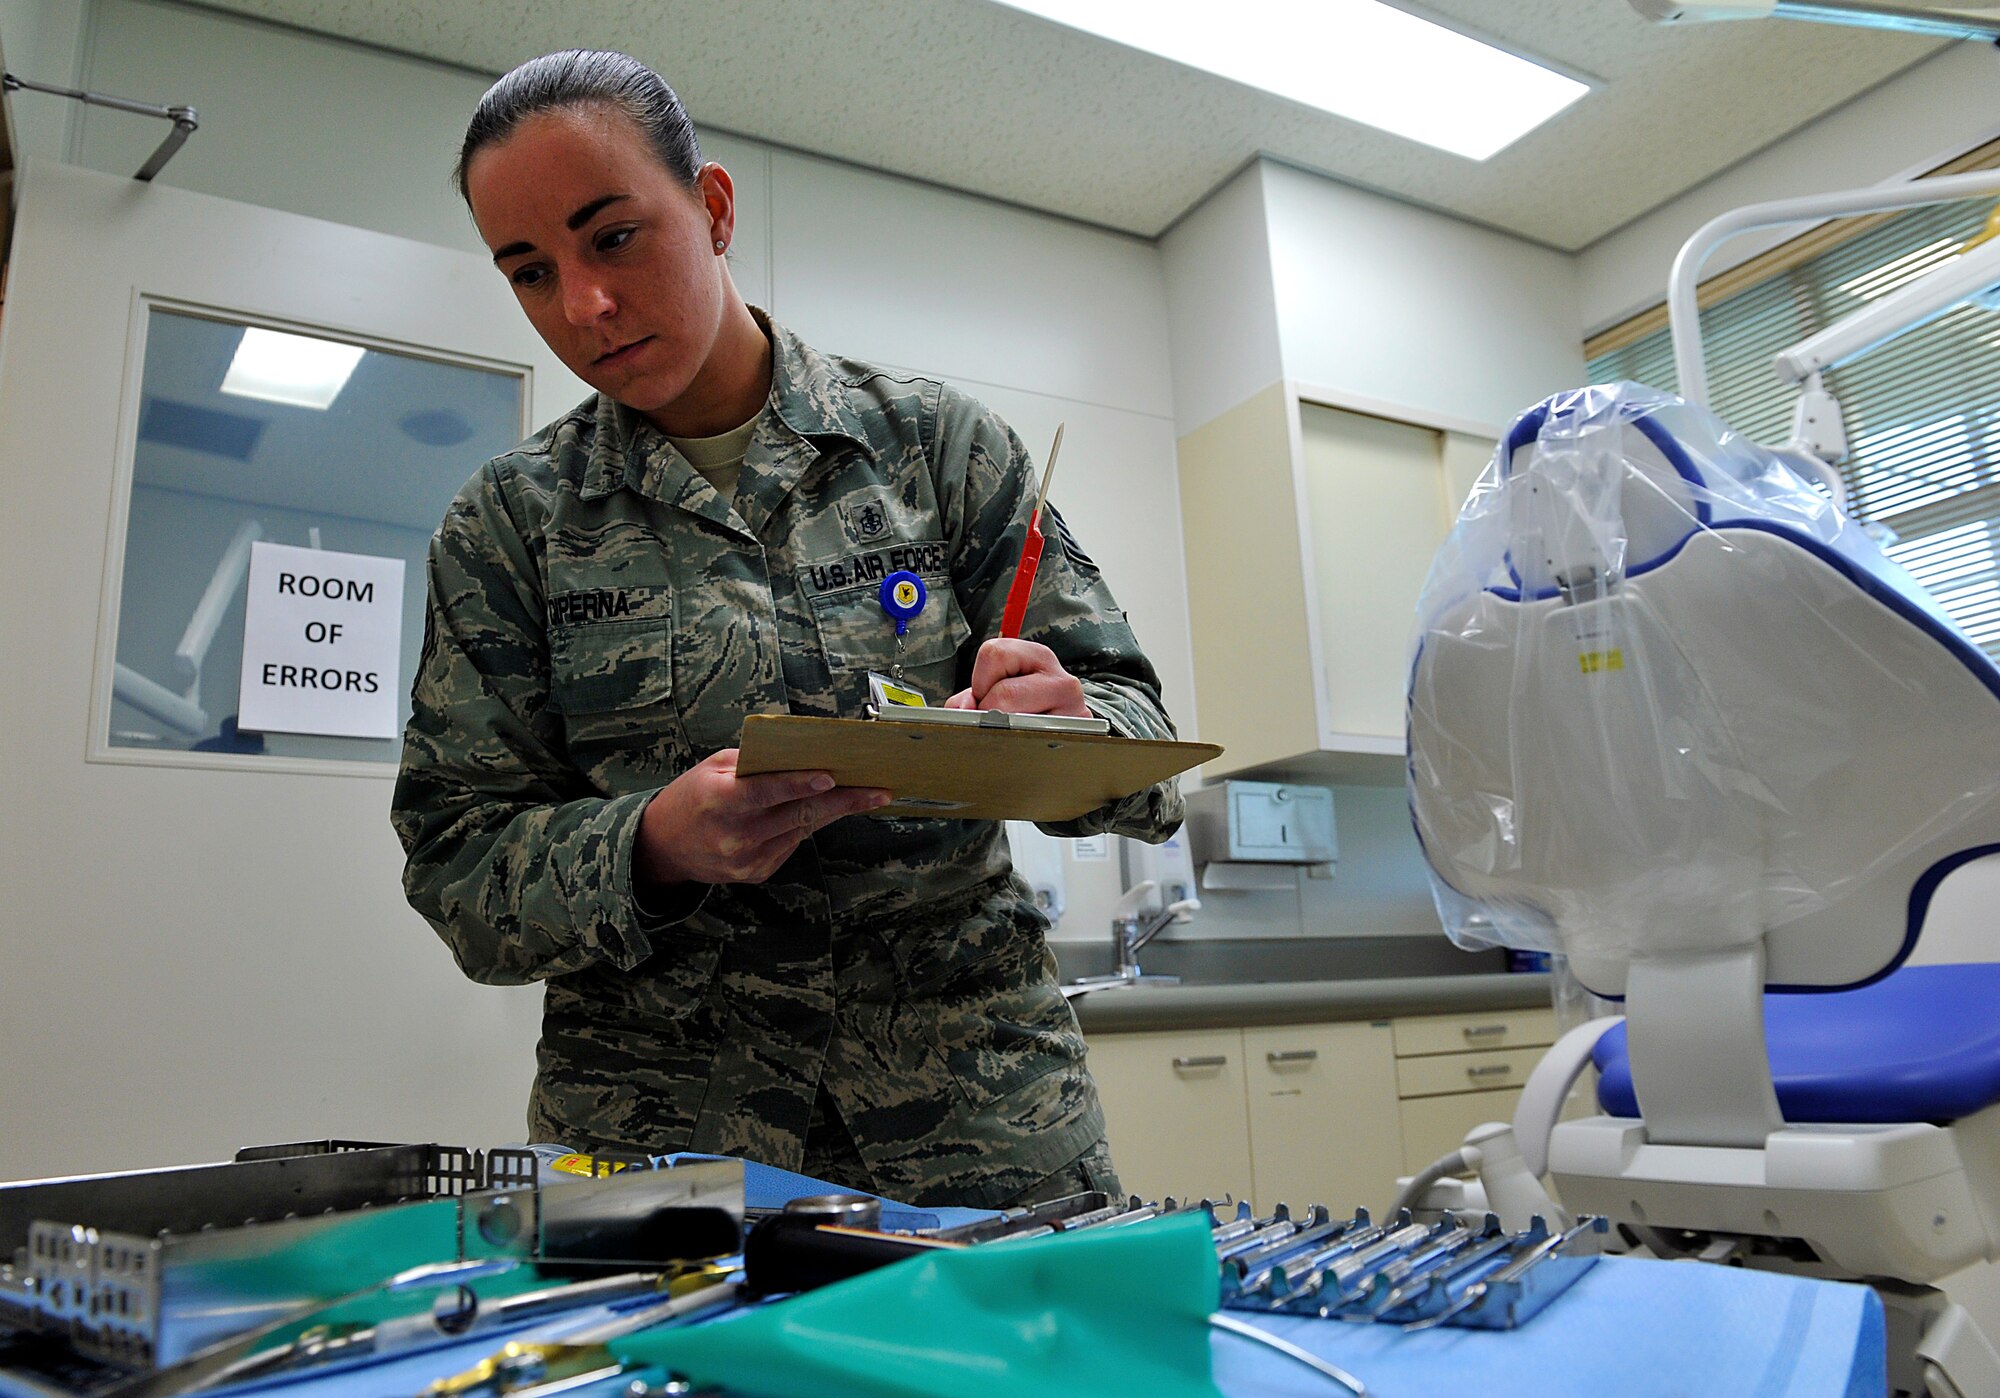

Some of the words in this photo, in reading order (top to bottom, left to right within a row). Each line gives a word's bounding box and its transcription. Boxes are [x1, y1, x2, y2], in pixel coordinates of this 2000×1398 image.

[853, 554, 886, 583] AIR
[890, 546, 942, 573] FORCE
[278, 572, 374, 604] ROOM
[305, 621, 343, 645] OF
[262, 663, 379, 694] ERRORS
